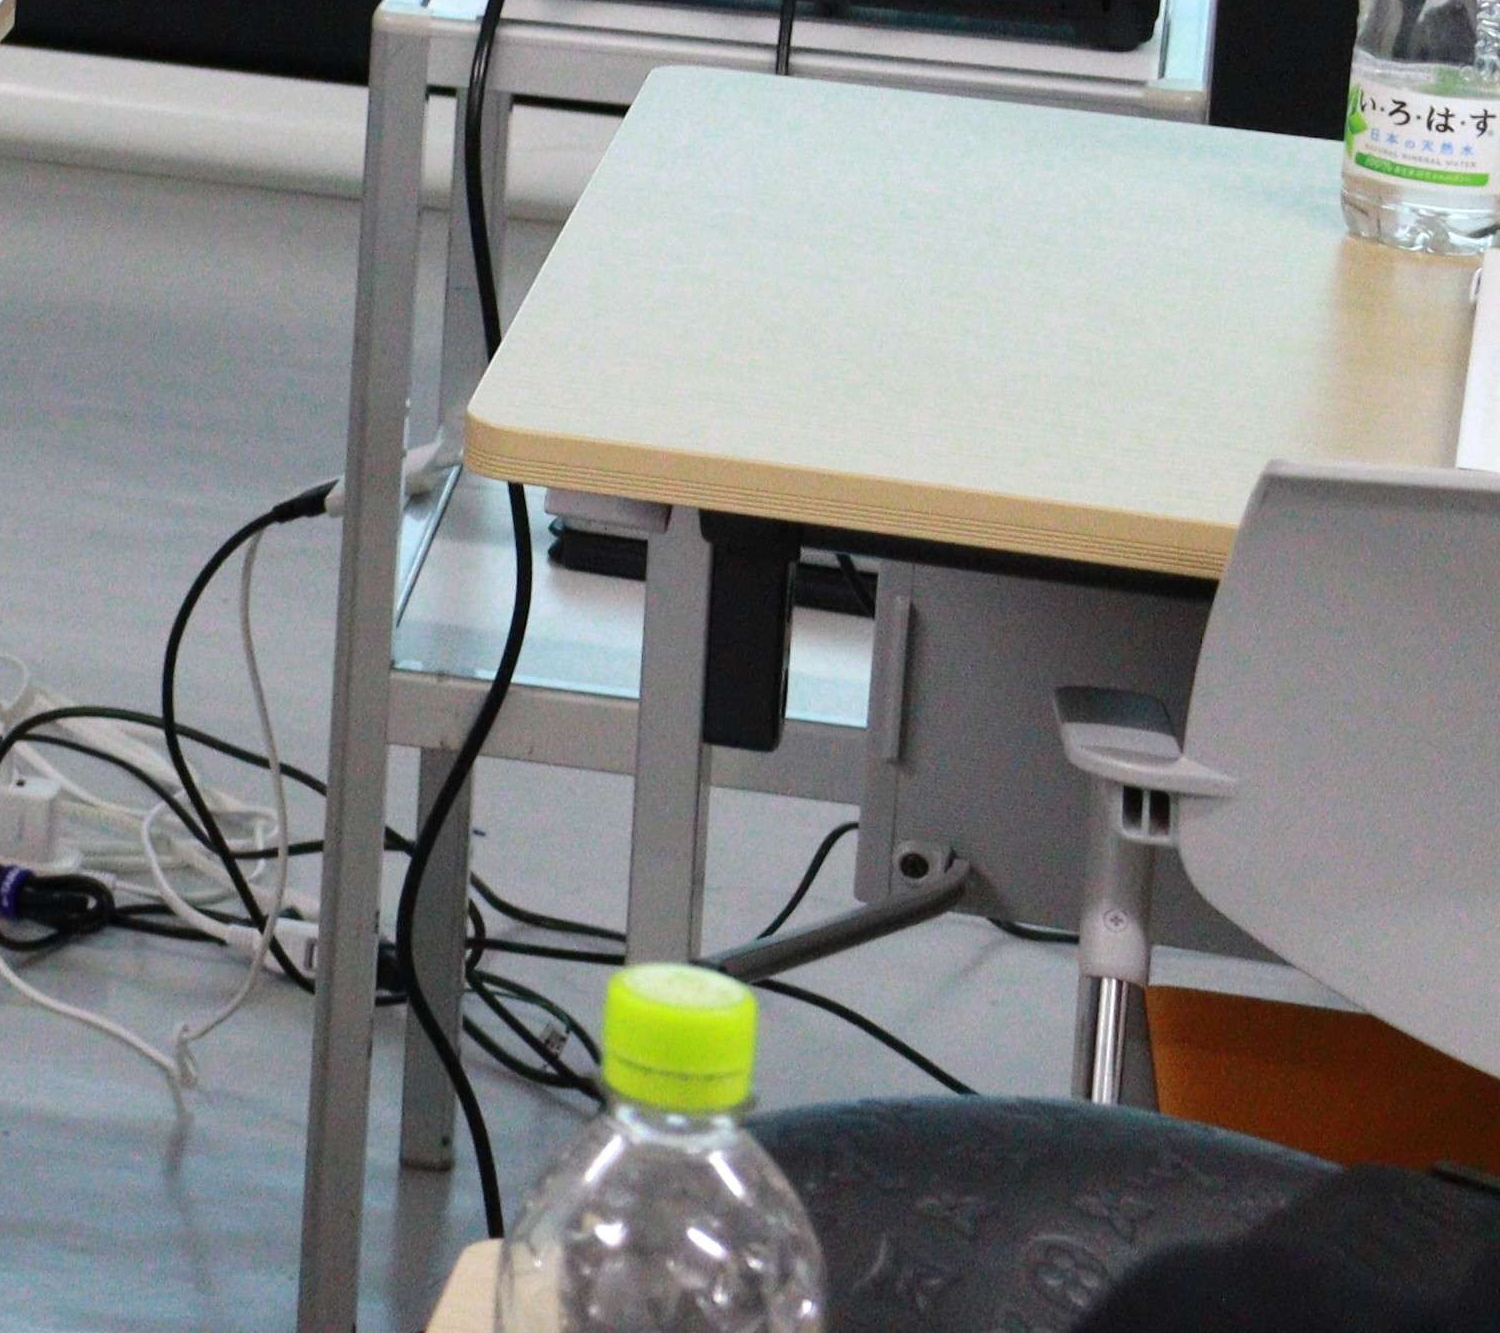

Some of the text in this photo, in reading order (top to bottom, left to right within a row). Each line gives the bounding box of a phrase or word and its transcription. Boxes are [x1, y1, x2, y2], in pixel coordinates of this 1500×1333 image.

[1370, 127, 1475, 157] 日本の天然水
